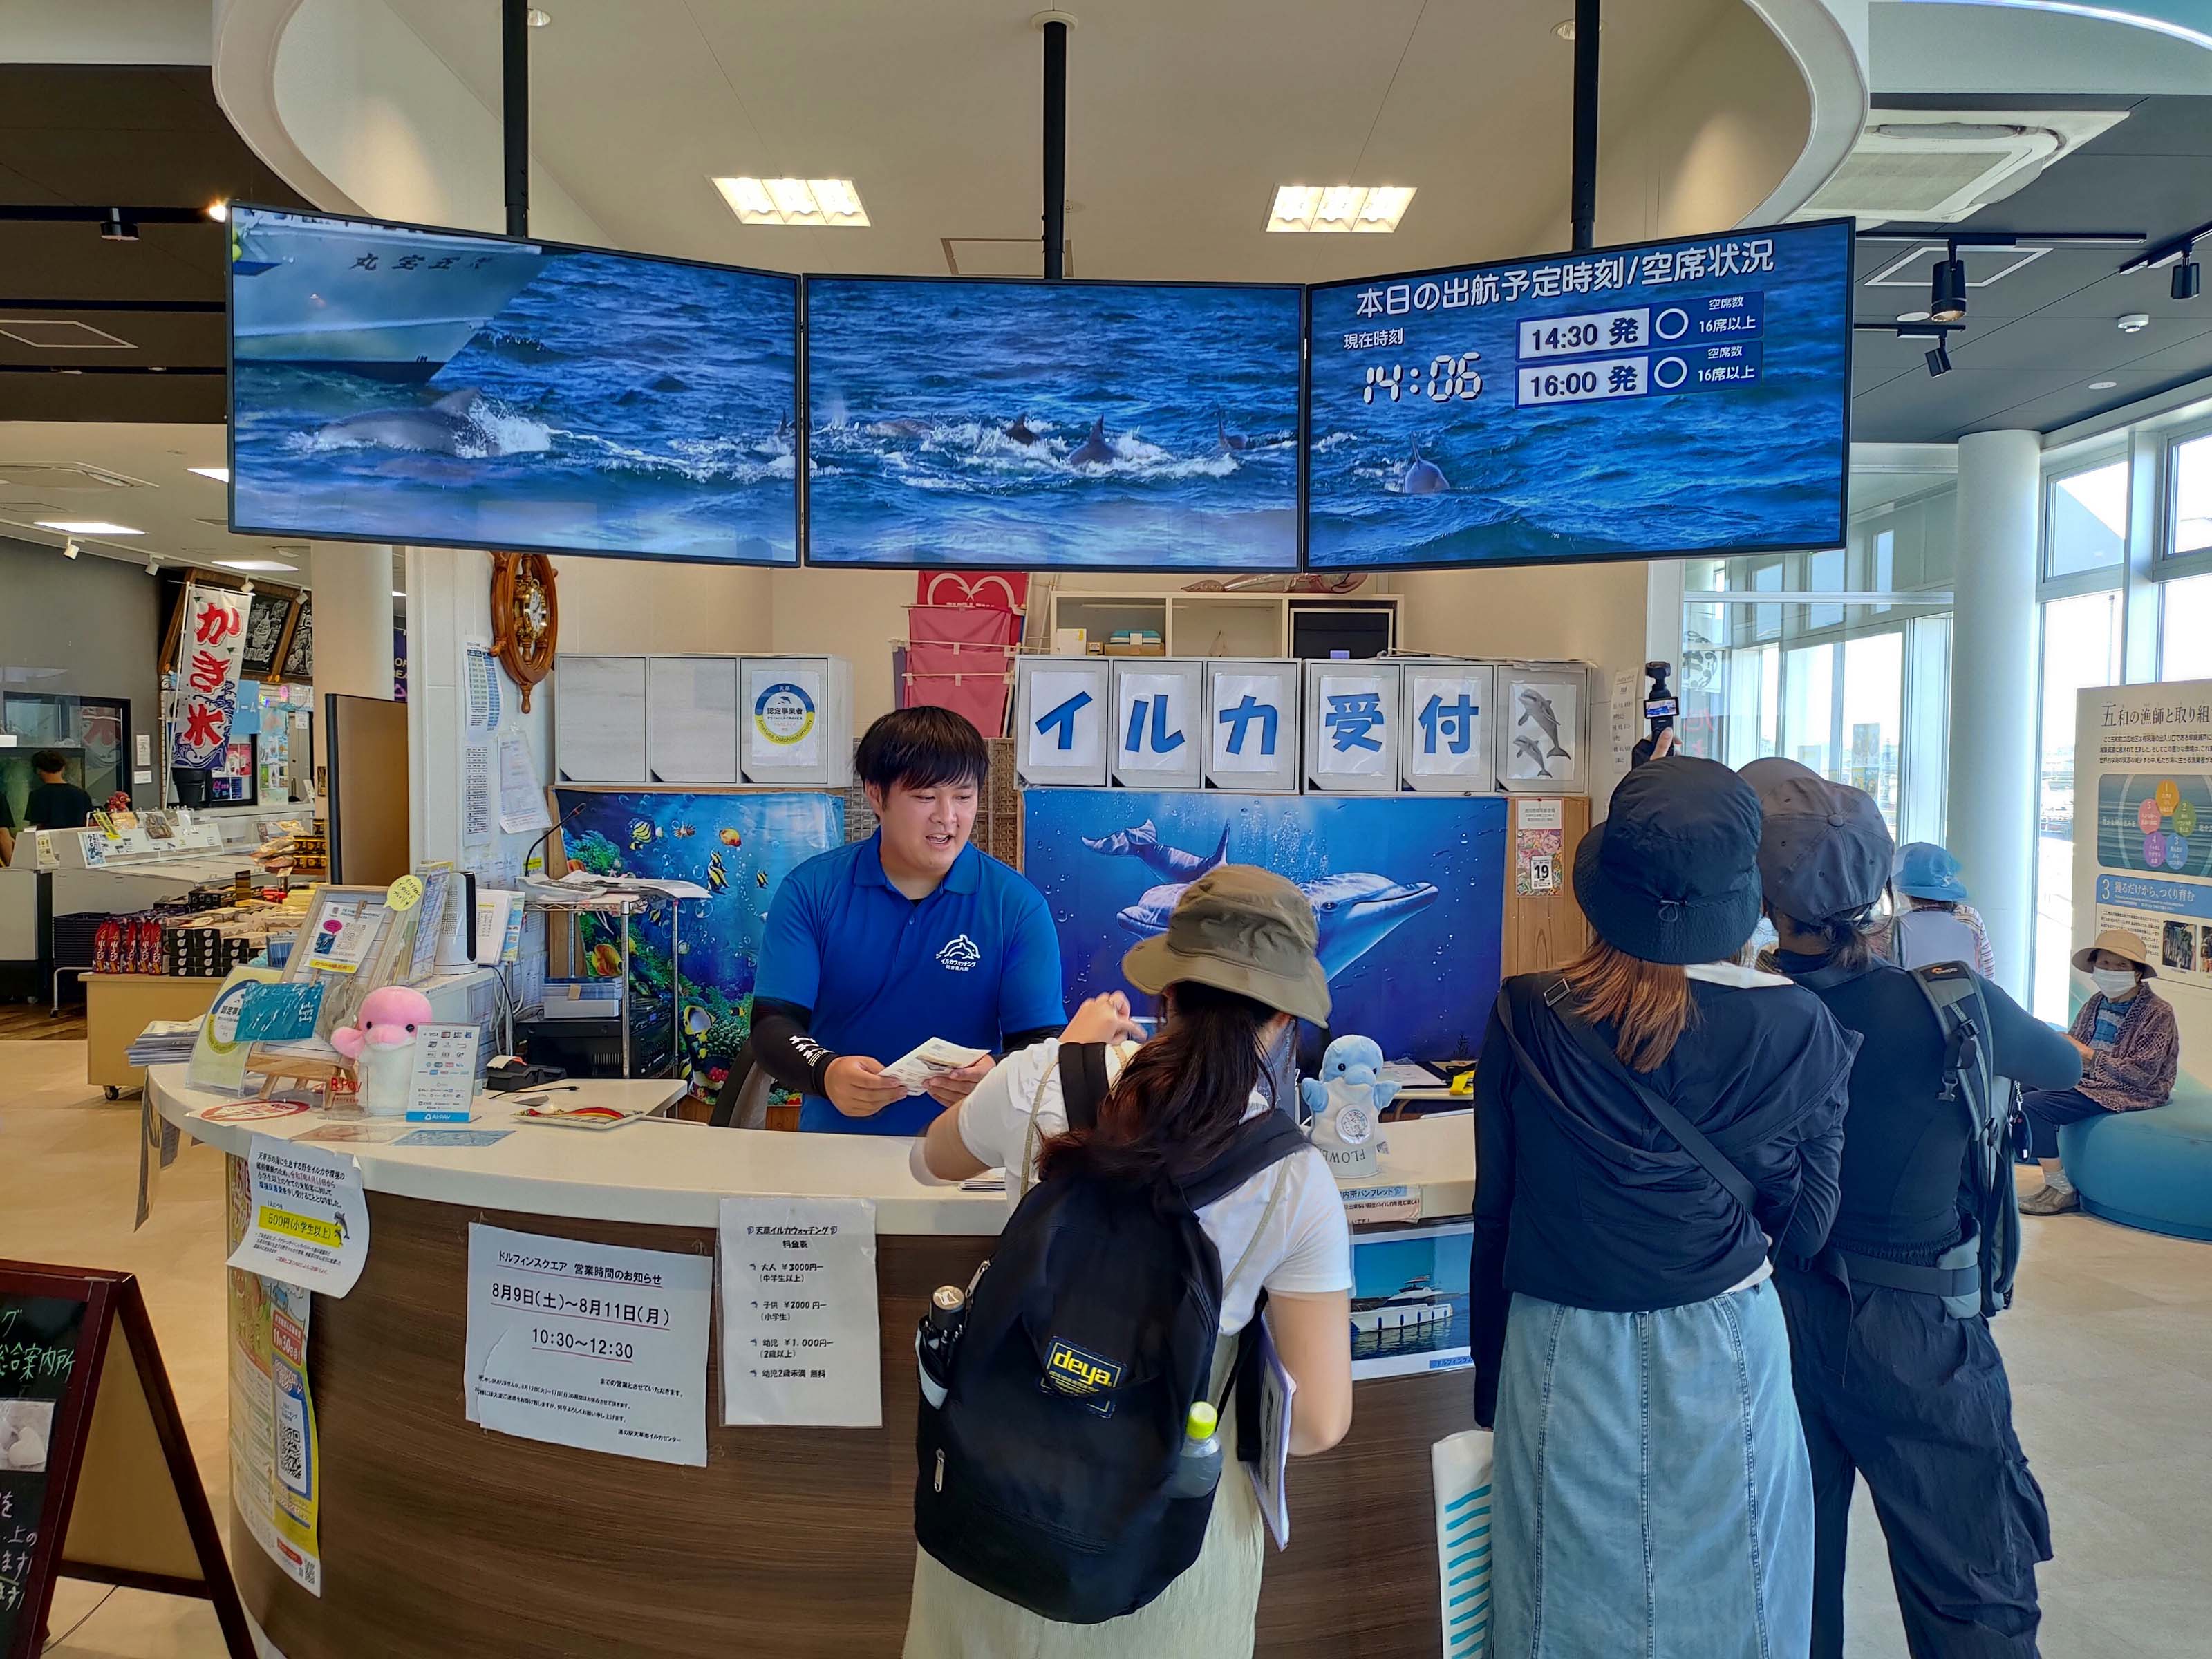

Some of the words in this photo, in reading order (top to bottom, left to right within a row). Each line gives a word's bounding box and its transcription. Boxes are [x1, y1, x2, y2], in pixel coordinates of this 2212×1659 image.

[1356, 238, 1775, 318] 本日の出航予定時刻/空席状況
[1708, 295, 1745, 310] 空席数
[1698, 315, 1757, 334] 16席以上
[1343, 328, 1404, 350] 現在時刻
[1531, 324, 1598, 351] 14:30
[1609, 317, 1639, 344] 発
[1707, 345, 1743, 359] 空席数
[1363, 351, 1483, 405] 14:06
[1530, 372, 1597, 397] 16:00
[1609, 366, 1638, 392] 発
[1698, 365, 1756, 383] 16席以上
[182, 601, 243, 748] かき氷
[1035, 691, 1480, 755] イルカ受付
[1534, 865, 1549, 879] 19
[2101, 879, 2110, 900] 3
[1318, 1147, 1366, 1163] FLOWE
[1340, 1188, 1393, 1199] 内所パンフレット
[782, 1240, 808, 1248] 料金表
[498, 1250, 568, 1271] ドルフィンスクエア
[574, 1262, 662, 1285] 営業時間のお知らせ
[761, 1263, 776, 1271] 大人
[763, 1301, 778, 1309] 子供
[762, 1338, 778, 1347] 幼児
